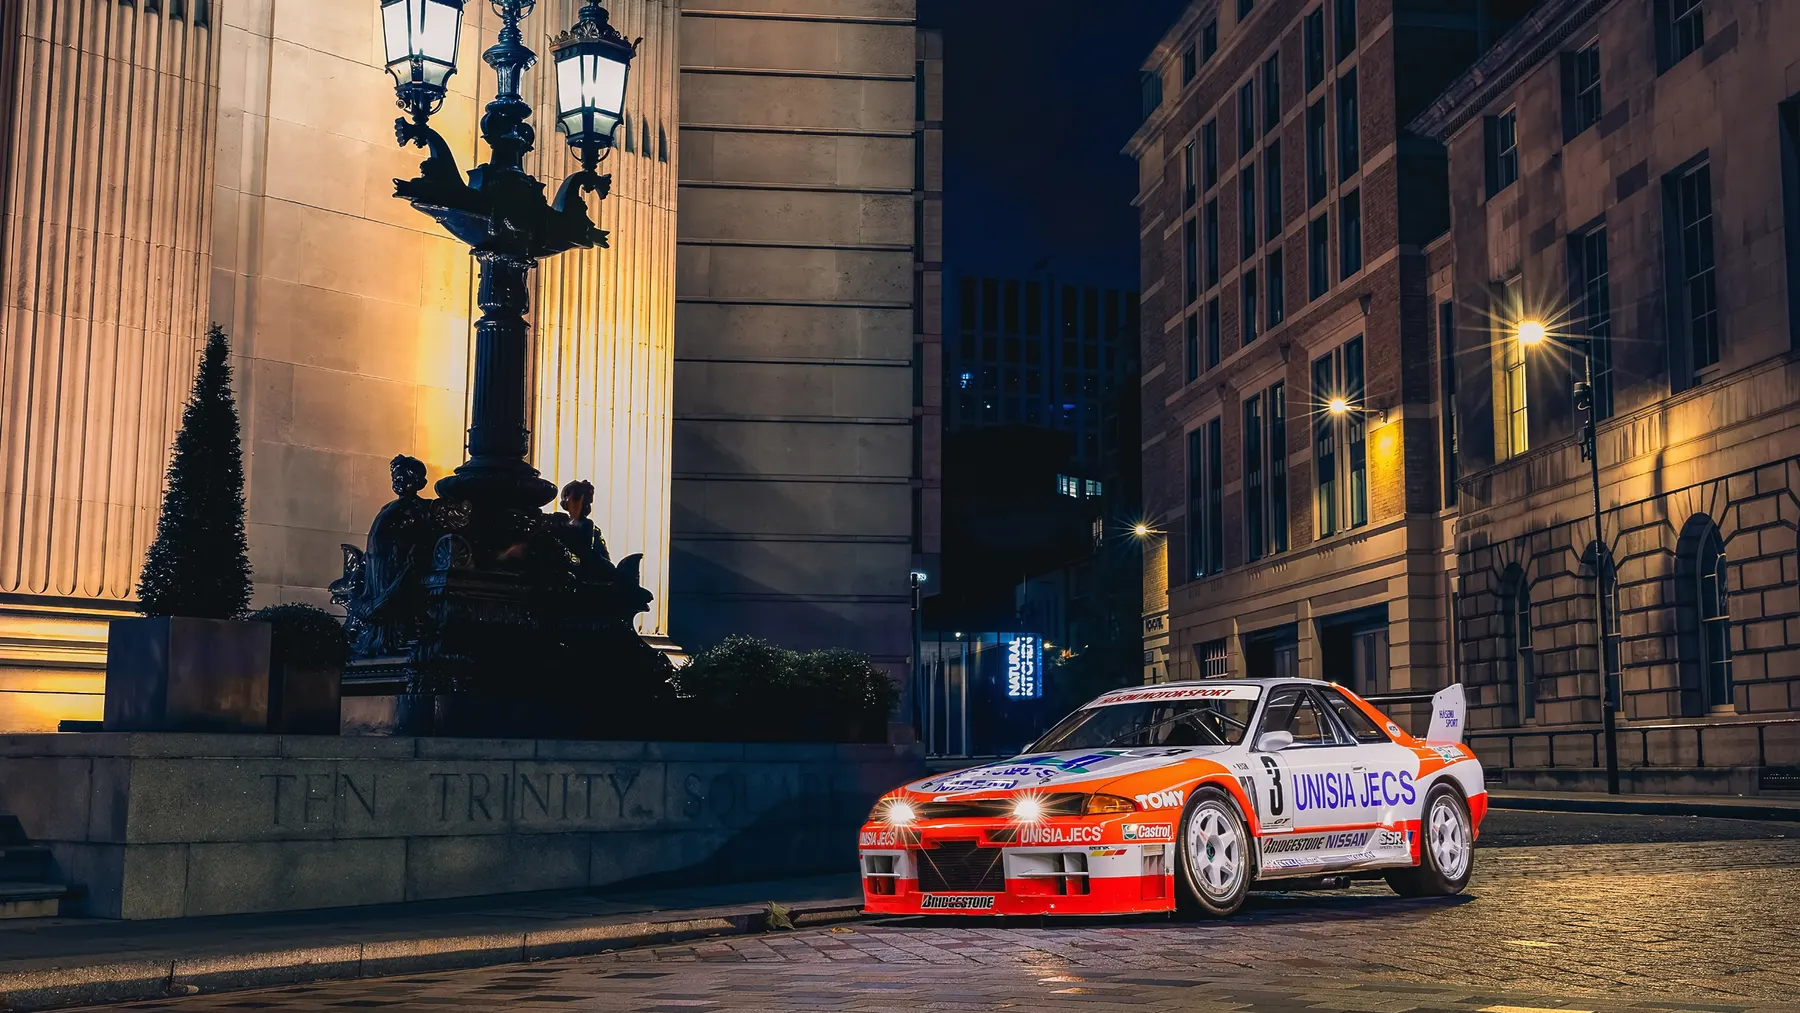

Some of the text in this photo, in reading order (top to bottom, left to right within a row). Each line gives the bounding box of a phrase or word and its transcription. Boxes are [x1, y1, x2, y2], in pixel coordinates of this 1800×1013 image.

[1009, 636, 1020, 696] NATURAL
[1445, 719, 1458, 727] SPORT
[1260, 756, 1283, 816] 3
[1293, 770, 1416, 811] UNISIA JECS
[260, 773, 377, 824] TEN
[429, 768, 641, 822] TRINITY
[1135, 790, 1184, 809] TOMY
[877, 832, 895, 846] JECS
[1021, 826, 1102, 843] UNISIA JECS
[1138, 825, 1171, 838] Castrol
[1379, 831, 1404, 845] SSR
[1263, 832, 1369, 854] BRIDGESTONE NISSAN
[921, 894, 994, 909] BRIDGESTONE
